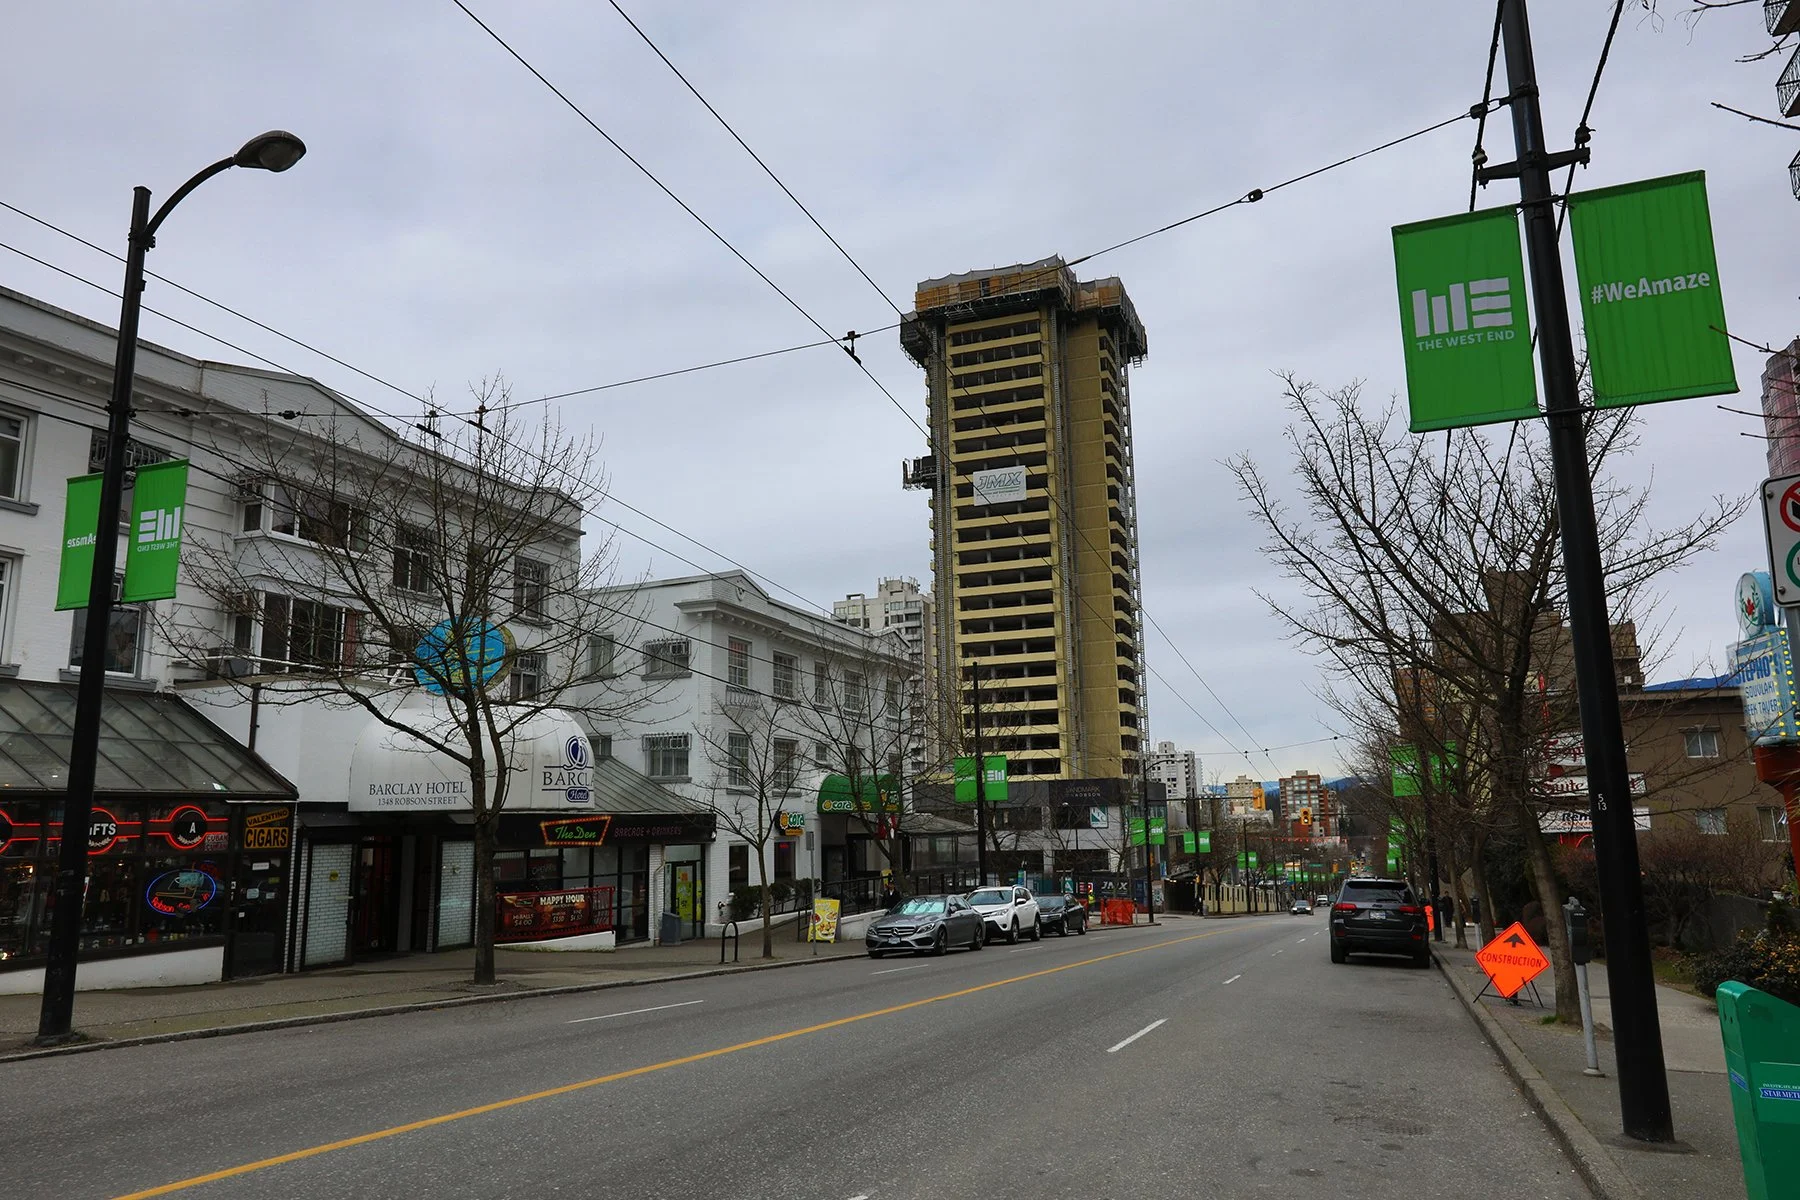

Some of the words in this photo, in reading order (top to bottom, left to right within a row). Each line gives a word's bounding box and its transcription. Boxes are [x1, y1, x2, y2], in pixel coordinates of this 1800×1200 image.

[1591, 271, 1711, 304] #WeAmaze
[1417, 339, 1443, 352] THE
[1446, 333, 1484, 348] WEST
[1487, 330, 1515, 343] END
[977, 471, 1022, 490] JMX
[1736, 653, 1783, 684] STEPHO'S
[1745, 681, 1775, 698] SOUVLAKI
[369, 783, 422, 796] BARCLAY
[426, 781, 467, 795] HOTEL
[569, 790, 588, 800] Hotel
[378, 798, 393, 806] 1348
[394, 797, 427, 806] ROBSON
[427, 796, 458, 805] STREET
[832, 801, 853, 810] cora
[1597, 794, 1604, 802] 5
[1597, 802, 1607, 811] 13
[248, 809, 288, 826] VALENTINO
[788, 813, 805, 827] cora
[245, 828, 287, 848] CIGARS
[555, 825, 573, 840] The
[573, 825, 597, 839] Den
[614, 826, 645, 838] BARCADE
[539, 895, 564, 906] HAPPY
[565, 894, 585, 904] HOUR
[1481, 952, 1542, 968] CONSTRUCTION
